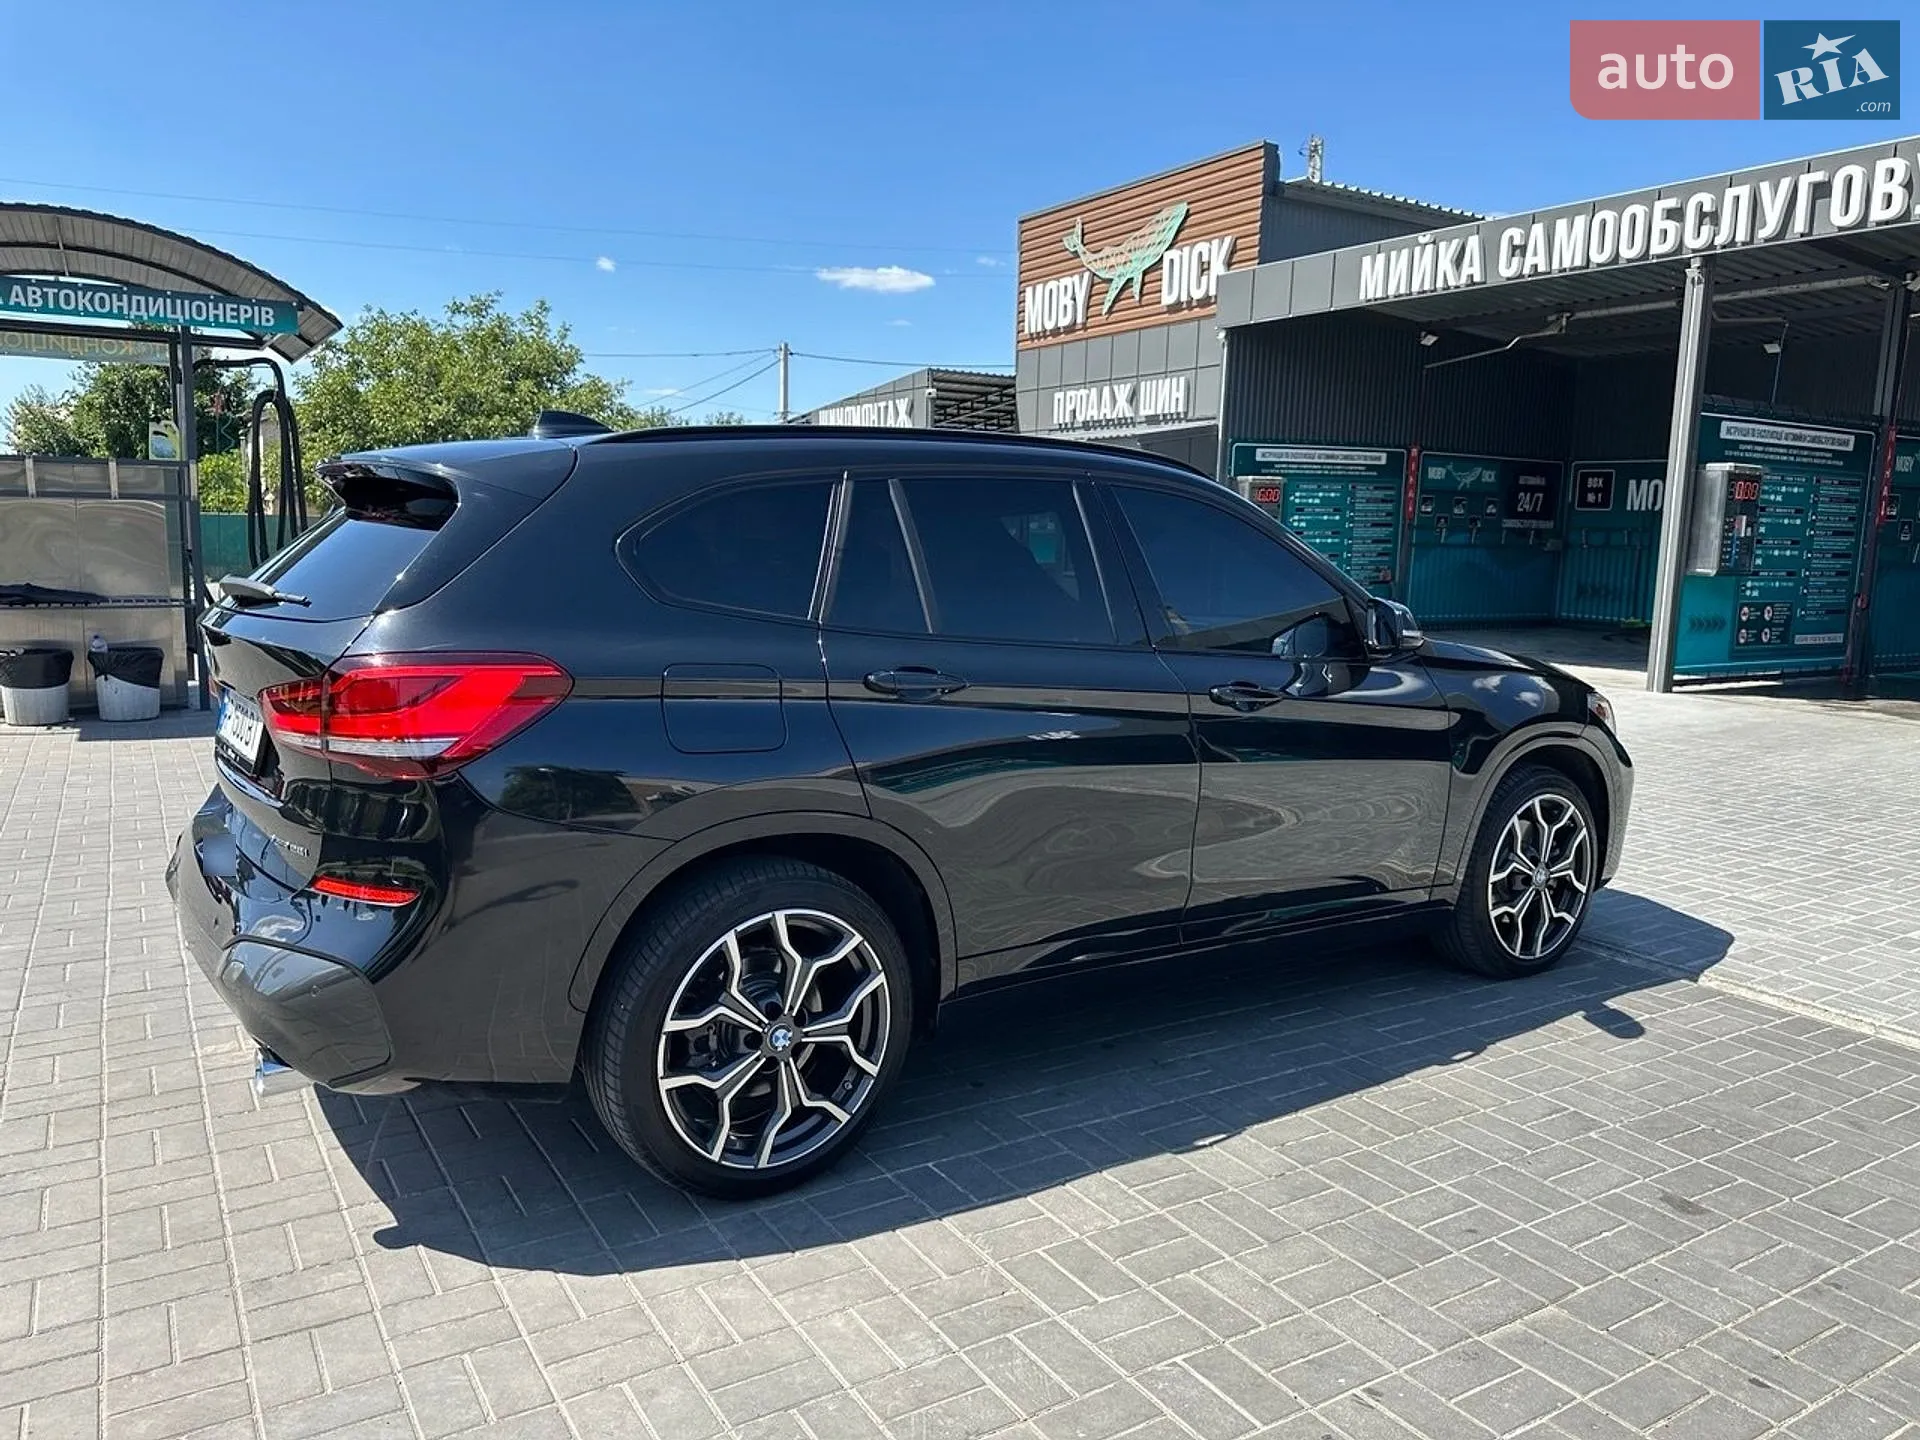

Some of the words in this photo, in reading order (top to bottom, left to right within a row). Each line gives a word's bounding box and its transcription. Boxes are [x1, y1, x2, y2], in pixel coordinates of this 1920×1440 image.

[1359, 232, 1486, 301] МИЙКА
[1498, 152, 1920, 279] САМООБСЛУГОВ
[8, 284, 275, 327] АВТОКОНДИЦІОНЕРІВ
[1024, 271, 1092, 334] MOBY
[1161, 236, 1235, 307] DICK
[1139, 376, 1187, 416] ШИН
[1516, 492, 1545, 513] 24/7
